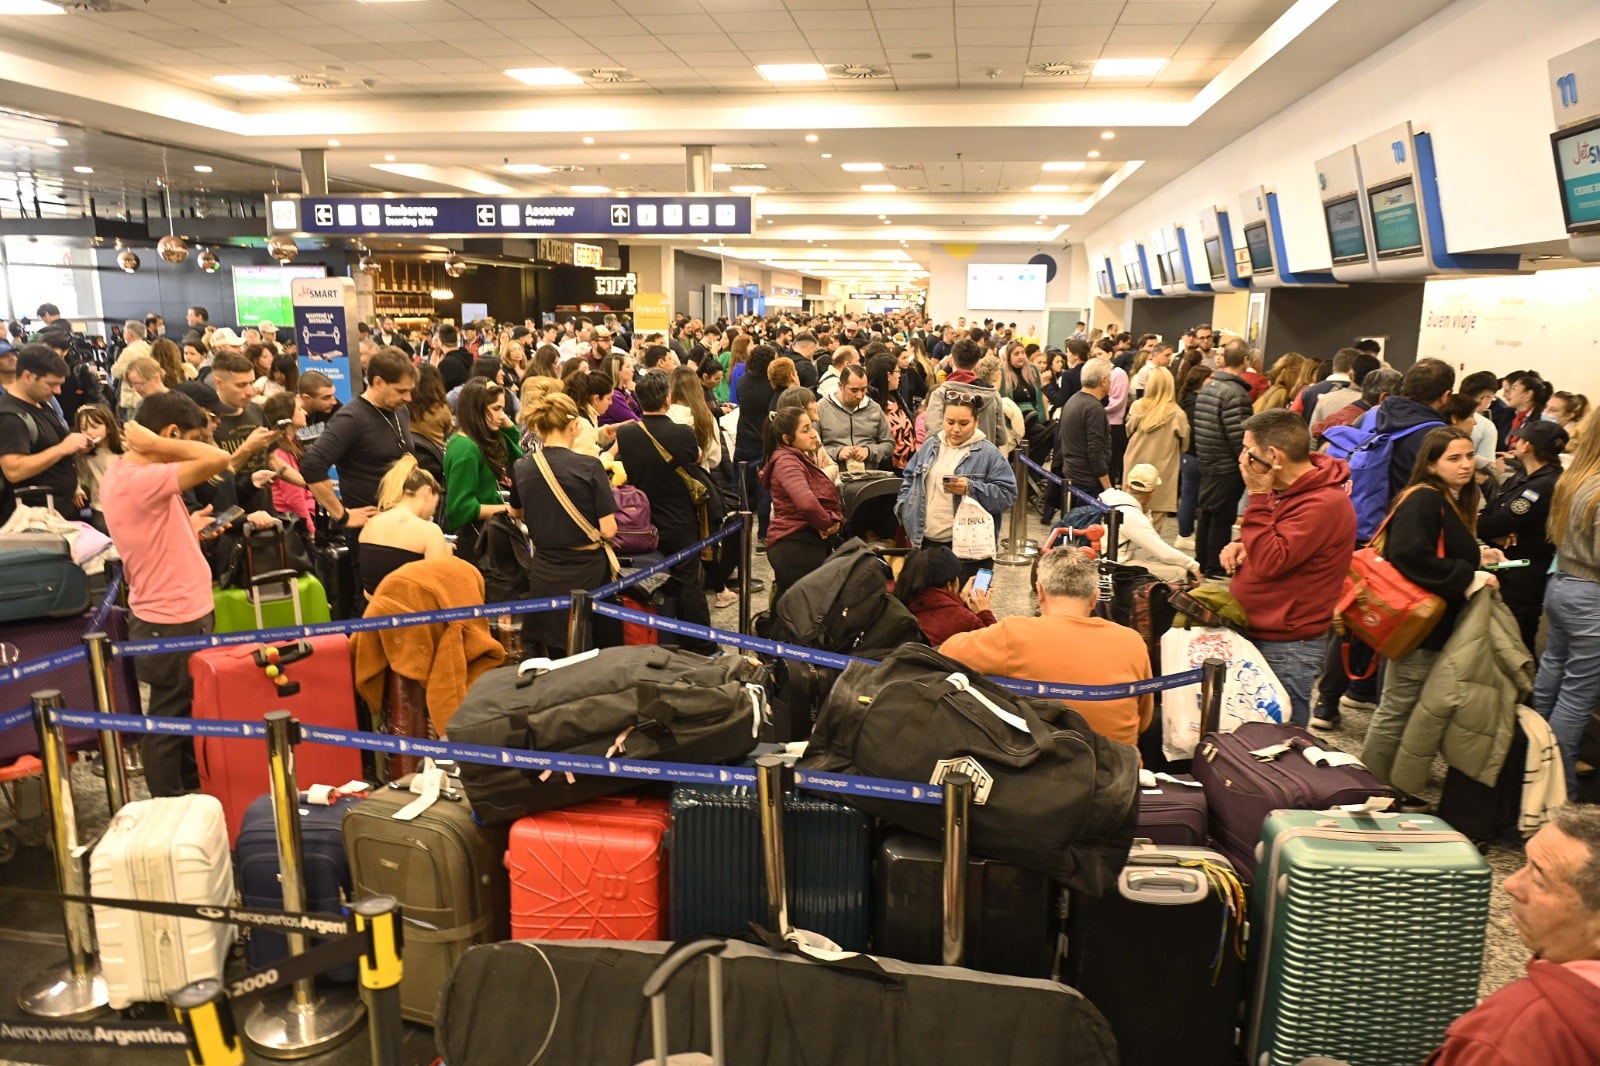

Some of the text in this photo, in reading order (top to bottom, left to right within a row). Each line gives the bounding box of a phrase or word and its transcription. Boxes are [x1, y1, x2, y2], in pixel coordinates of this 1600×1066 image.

[1557, 73, 1578, 106] 11
[1392, 141, 1406, 163] 10
[384, 204, 438, 218] Embarque
[525, 204, 575, 217] Ascensor
[385, 217, 418, 227] Boarding
[525, 217, 556, 226] Elevator
[298, 285, 338, 298] JetSMART
[315, 625, 346, 633] despegar
[402, 615, 432, 624] despegar
[484, 606, 511, 615] despegar
[1050, 687, 1084, 696] despegar
[312, 731, 346, 742] despegar
[412, 743, 448, 754] despegar
[515, 754, 552, 766] despegar
[622, 764, 660, 775] despegar
[807, 776, 849, 788] despegar
[230, 910, 300, 928] Aeropuertos
[231, 968, 279, 997] 2000
[1, 1023, 187, 1046] Aeropuertos Argentina
